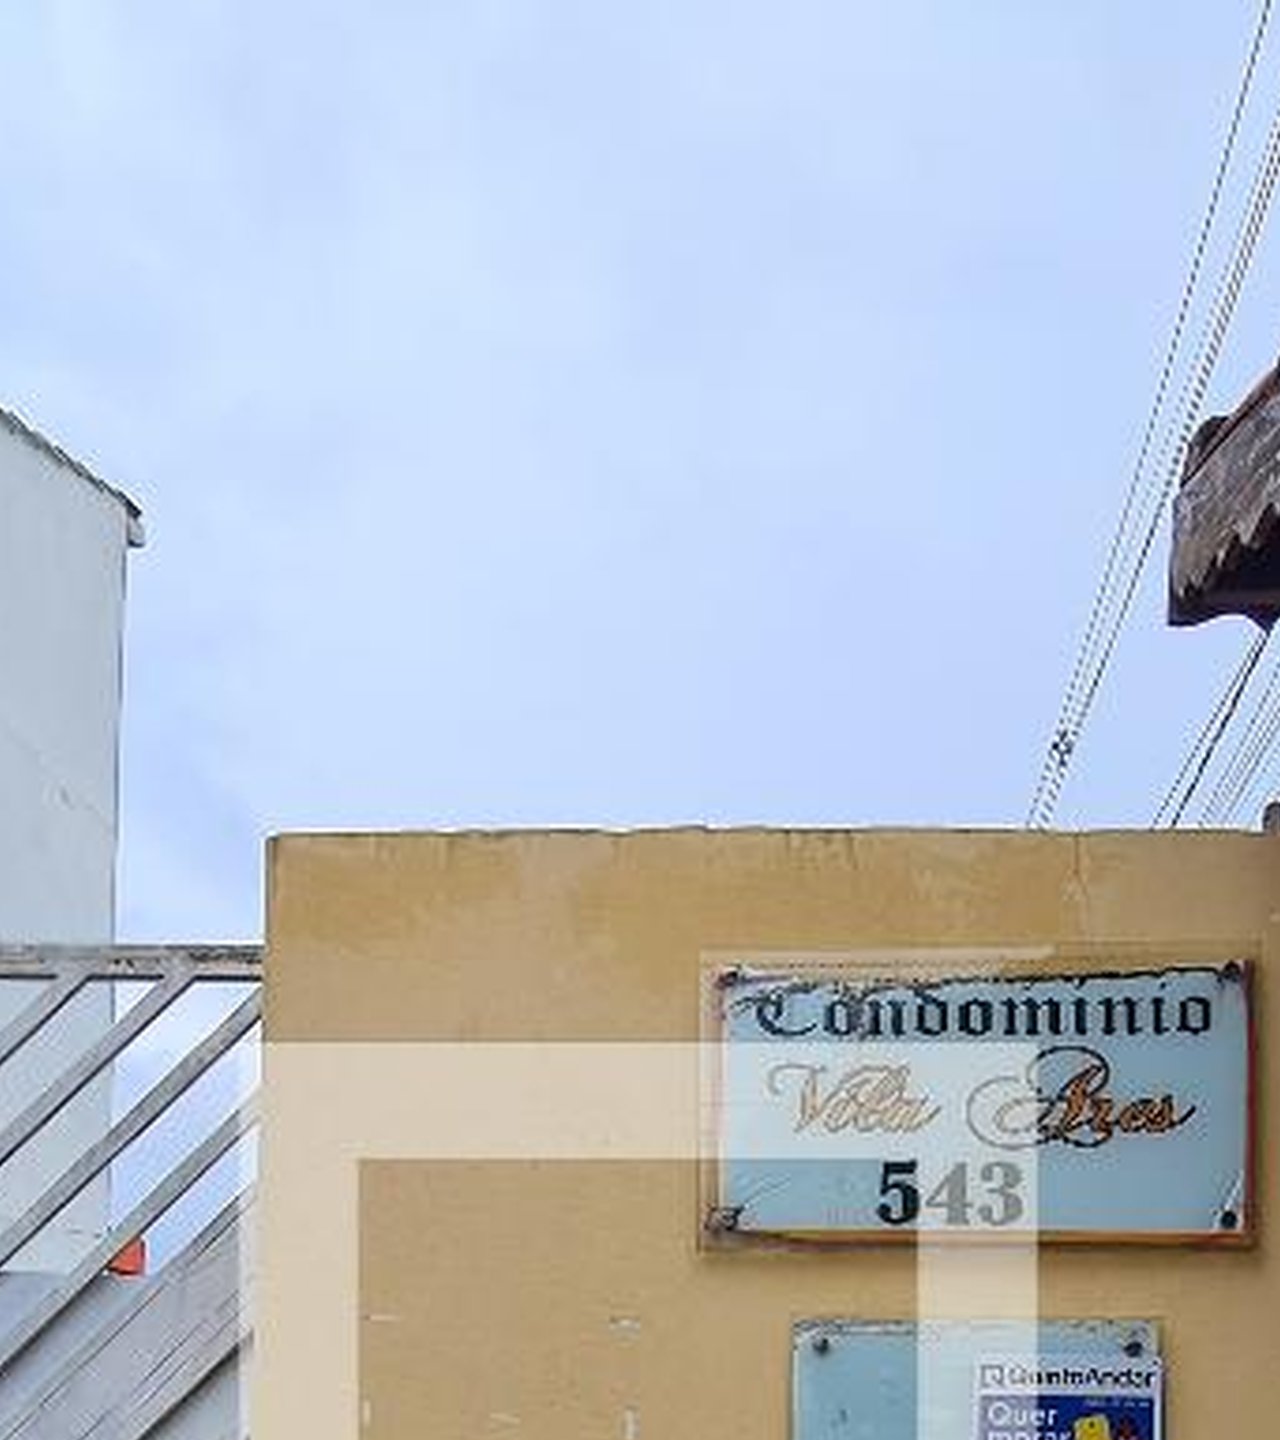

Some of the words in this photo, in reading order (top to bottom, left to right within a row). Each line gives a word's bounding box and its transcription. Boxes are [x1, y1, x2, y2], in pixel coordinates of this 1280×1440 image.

[754, 984, 1213, 1037] Condominio
[876, 1160, 1024, 1226] 543
[986, 1401, 1059, 1427] Quer
